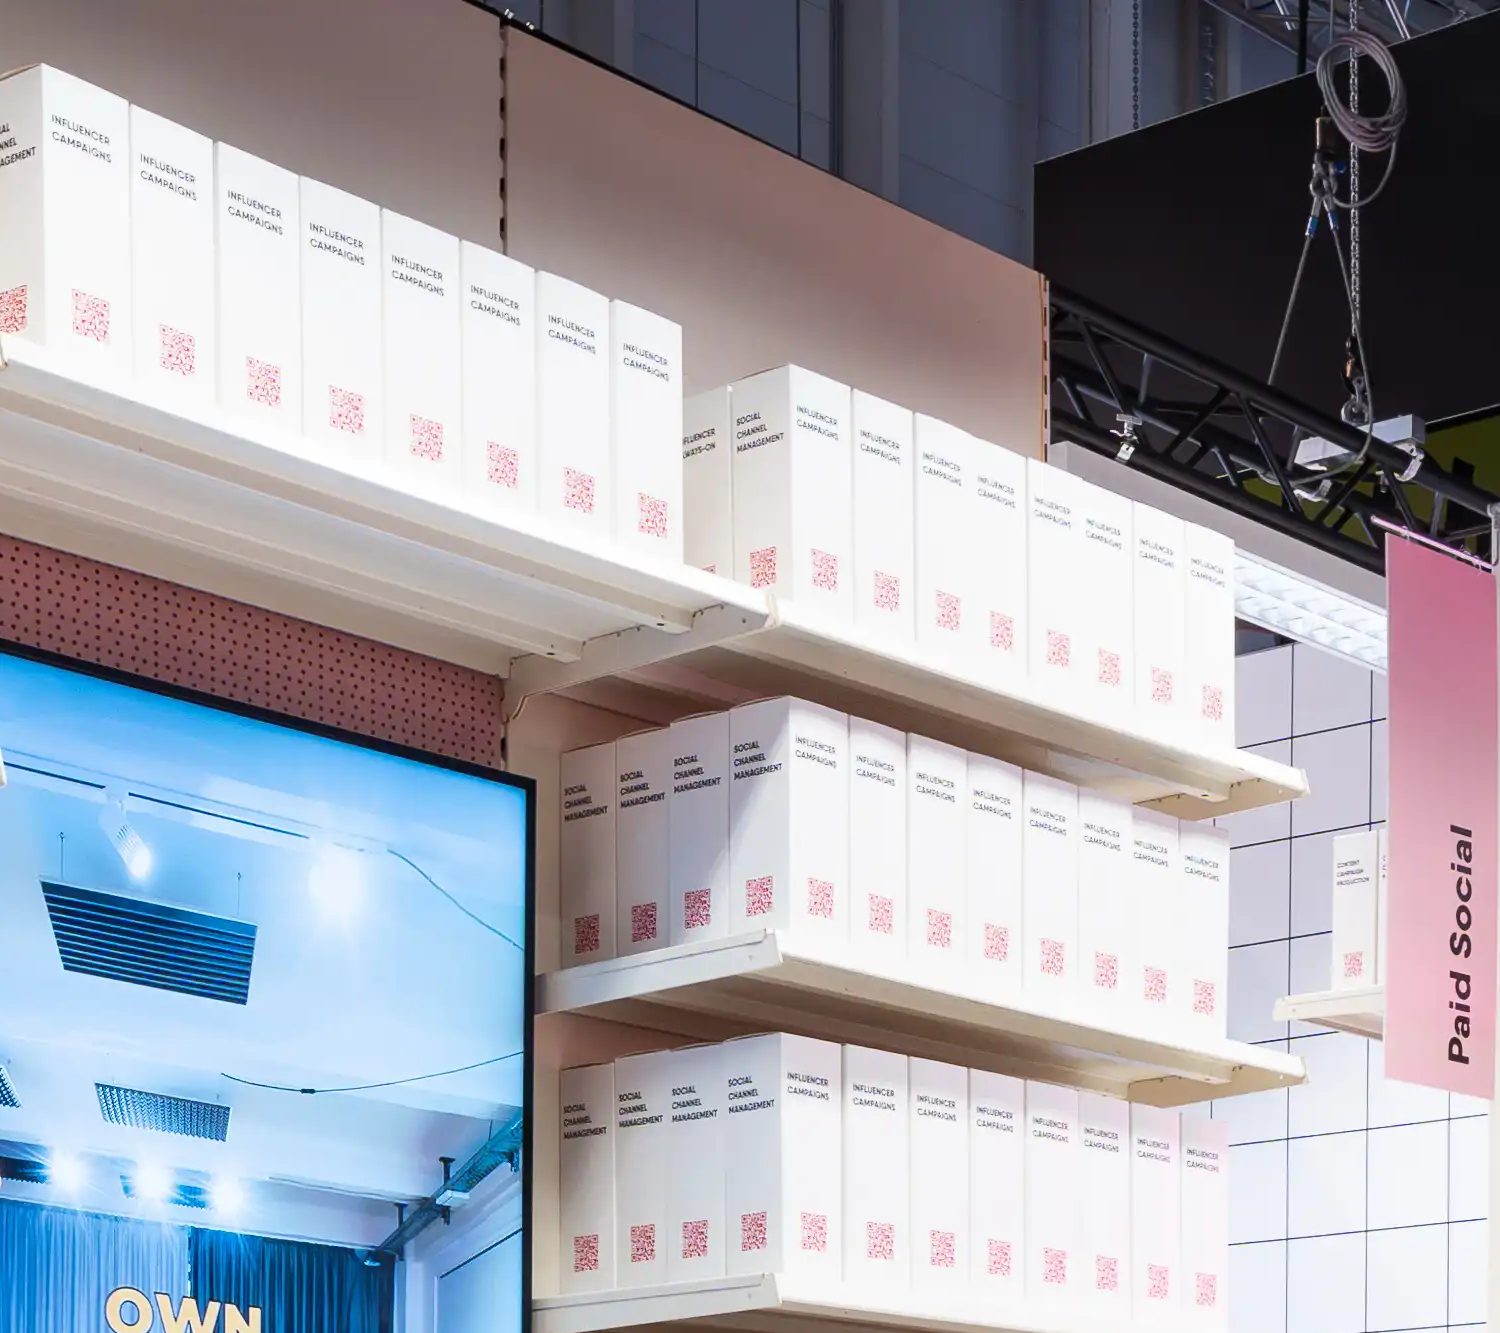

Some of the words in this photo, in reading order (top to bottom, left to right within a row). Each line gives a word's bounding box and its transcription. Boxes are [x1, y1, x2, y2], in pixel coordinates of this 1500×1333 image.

[51, 114, 110, 145] INFLUENCER
[51, 131, 112, 163] CAMPAIGNS
[309, 222, 364, 250] INFLUENCER
[309, 238, 365, 266] CAMPAIGNS
[548, 314, 595, 338] INFLUENCER
[547, 329, 596, 355] CAMPAIGNS
[733, 740, 760, 754] SOCIAL
[733, 752, 767, 767] CHANNEL
[733, 762, 783, 781] MANAGEMENT
[1448, 824, 1474, 960] Social
[1447, 969, 1472, 1065] Paid
[727, 1076, 753, 1088] SOCIAL
[786, 1072, 829, 1087] INFLUENCER
[728, 1088, 759, 1101] CHANNEL
[787, 1085, 830, 1101] CAMPAIGNS
[728, 1098, 775, 1114] MANAGEMENT
